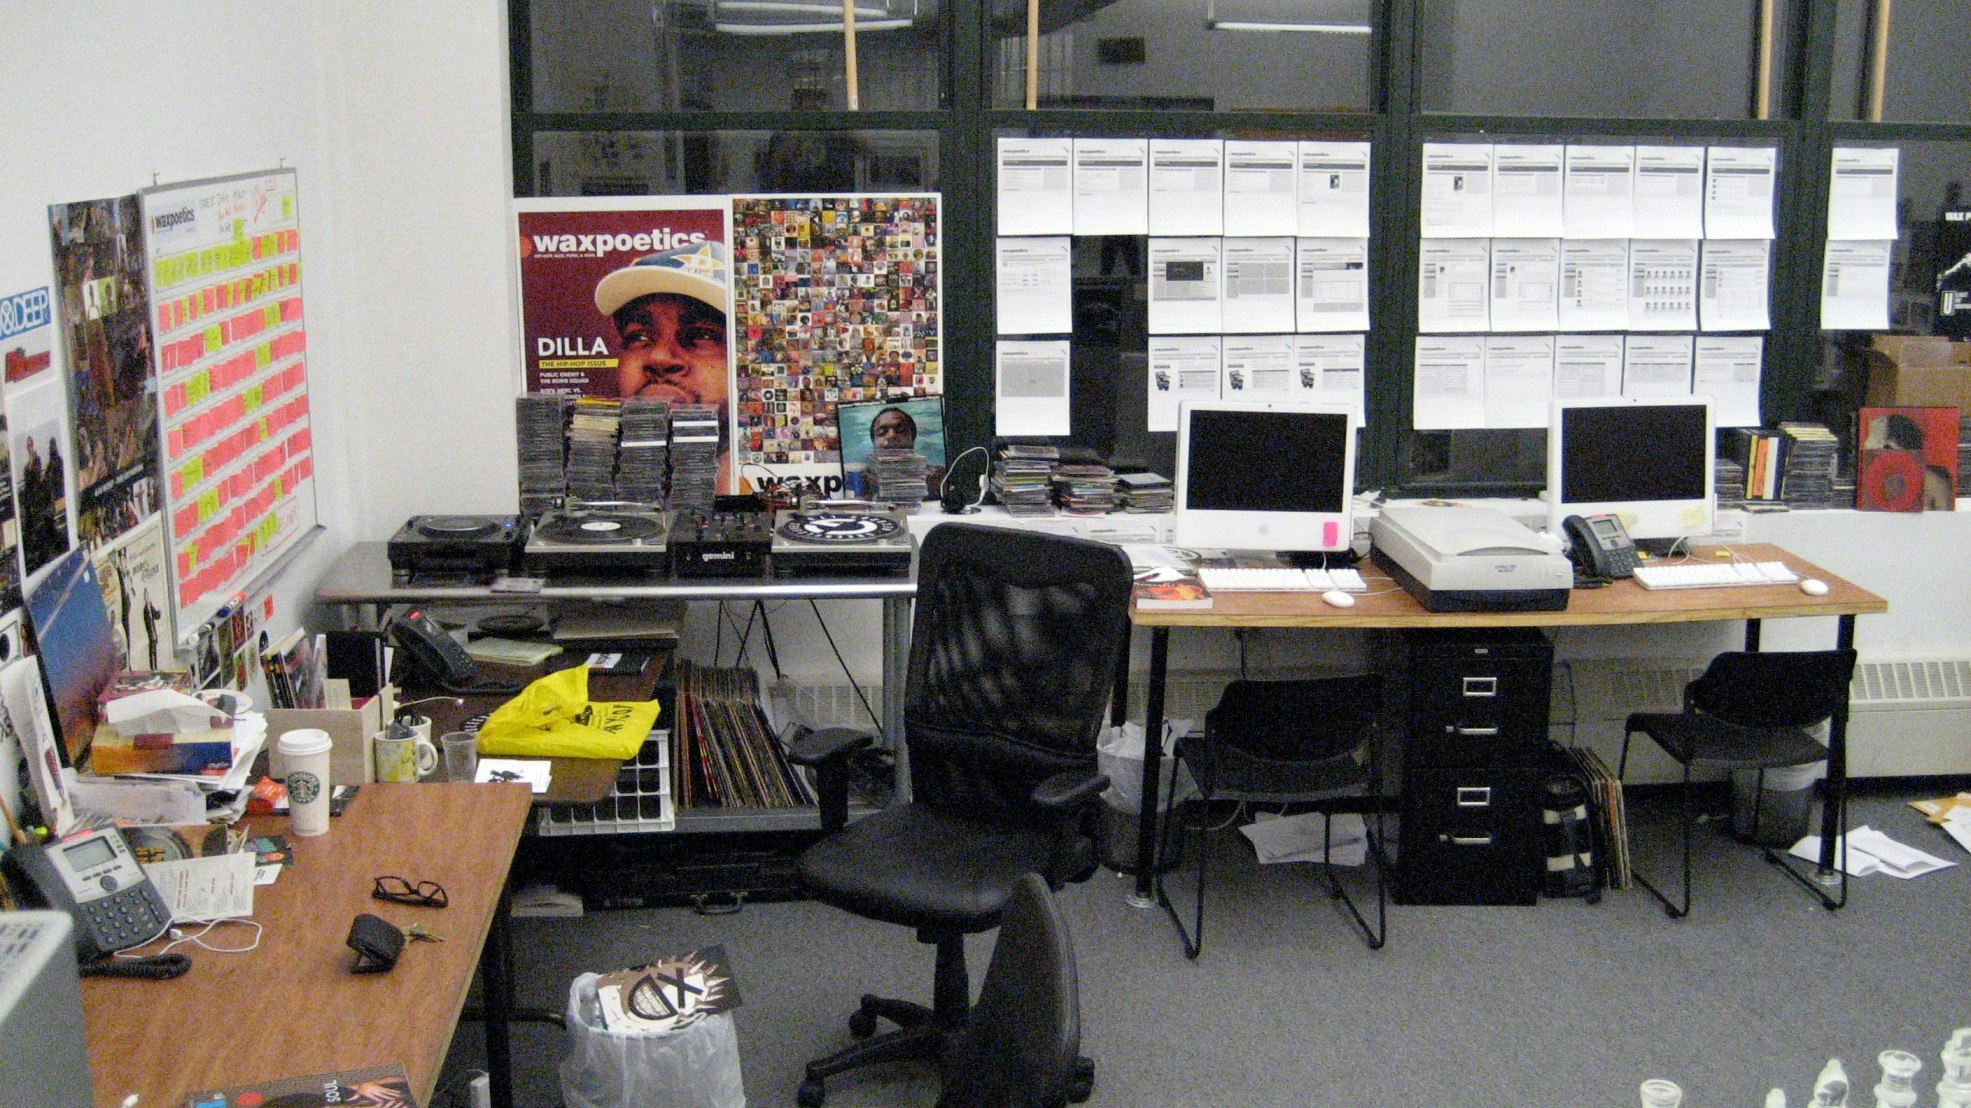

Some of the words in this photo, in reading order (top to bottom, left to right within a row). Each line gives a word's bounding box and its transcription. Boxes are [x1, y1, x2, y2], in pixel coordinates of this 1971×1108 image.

[533, 228, 706, 257] waxpoetics
[538, 337, 610, 356] DILLA
[702, 551, 735, 562] gemini
